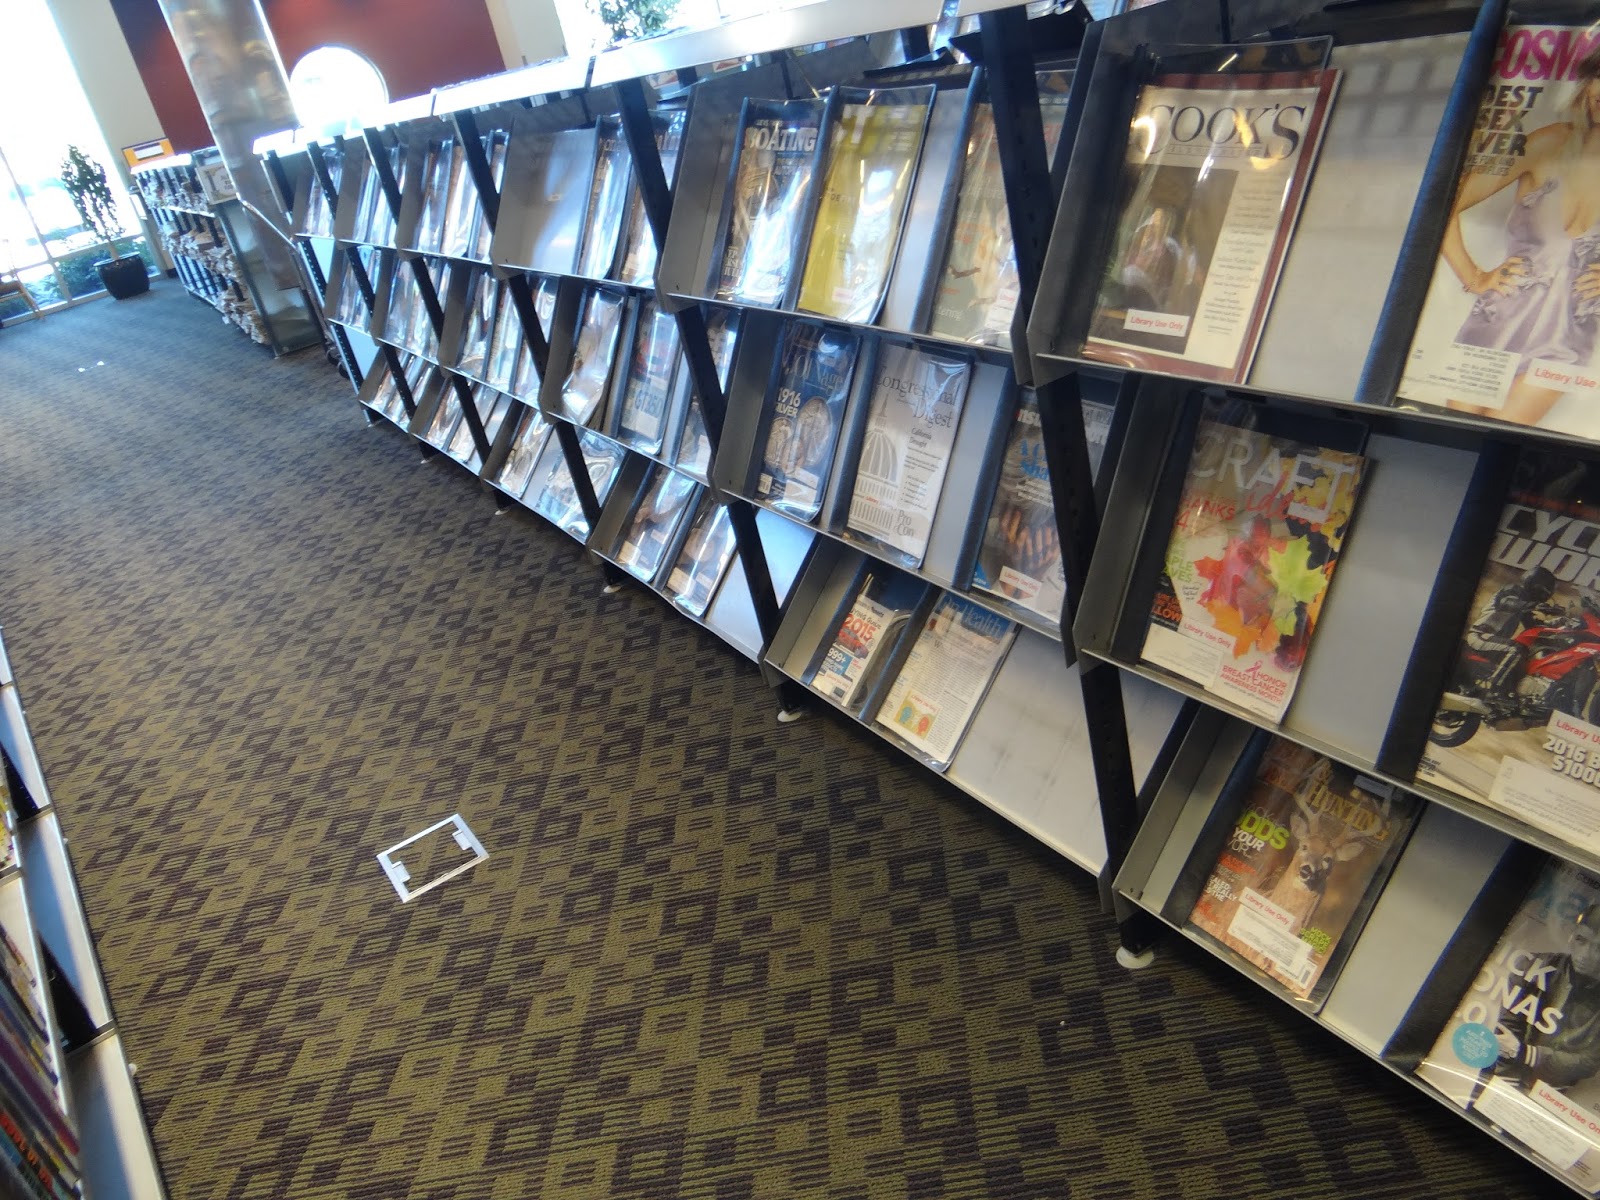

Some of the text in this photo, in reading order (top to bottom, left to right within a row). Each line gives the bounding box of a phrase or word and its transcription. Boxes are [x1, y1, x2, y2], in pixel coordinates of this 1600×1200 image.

[1491, 29, 1600, 81] OSM
[1141, 103, 1306, 160] COOK'S
[1130, 316, 1184, 333] Library Use Only
[1534, 367, 1597, 388] Library Use
[778, 387, 801, 407] 1916
[913, 399, 952, 428] Digest
[843, 613, 876, 641] 2015
[960, 601, 1002, 634] Health
[827, 648, 846, 663] 999+
[1222, 664, 1251, 685] BREAST
[1556, 719, 1589, 740] Library
[1542, 735, 1587, 763] 2016
[1232, 827, 1265, 851] YOUR
[1239, 810, 1290, 850] DDS
[1497, 949, 1557, 992] ICK
[1472, 969, 1563, 1034] ONAS
[1538, 1088, 1569, 1114] Library
[1570, 1109, 1586, 1124] Use
